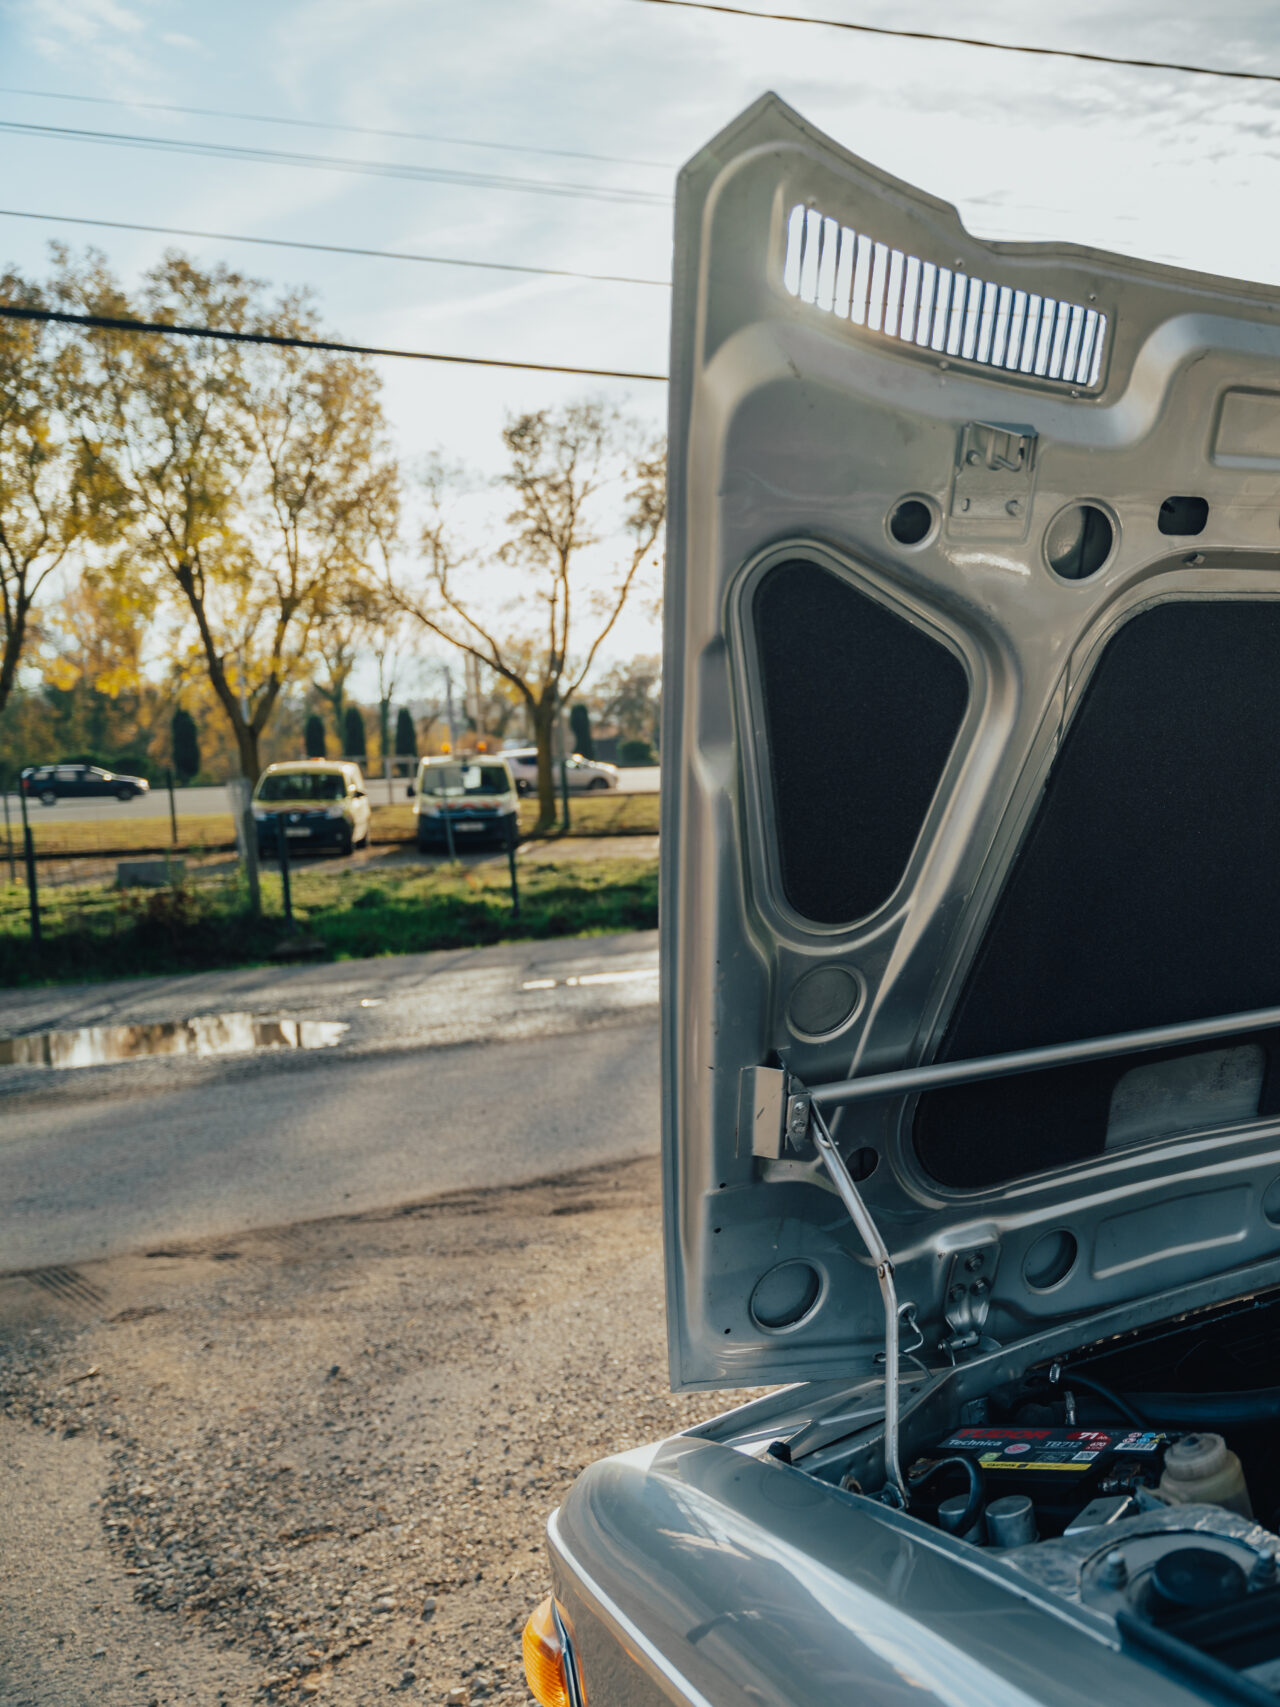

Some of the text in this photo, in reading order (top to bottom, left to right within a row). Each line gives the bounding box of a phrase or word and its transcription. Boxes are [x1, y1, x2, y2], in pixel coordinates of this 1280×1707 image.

[957, 1428, 1052, 1440] TUDOR
[1078, 1431, 1100, 1440] 71
[948, 1439, 1002, 1447] Technica
[1044, 1440, 1083, 1449] TB712
